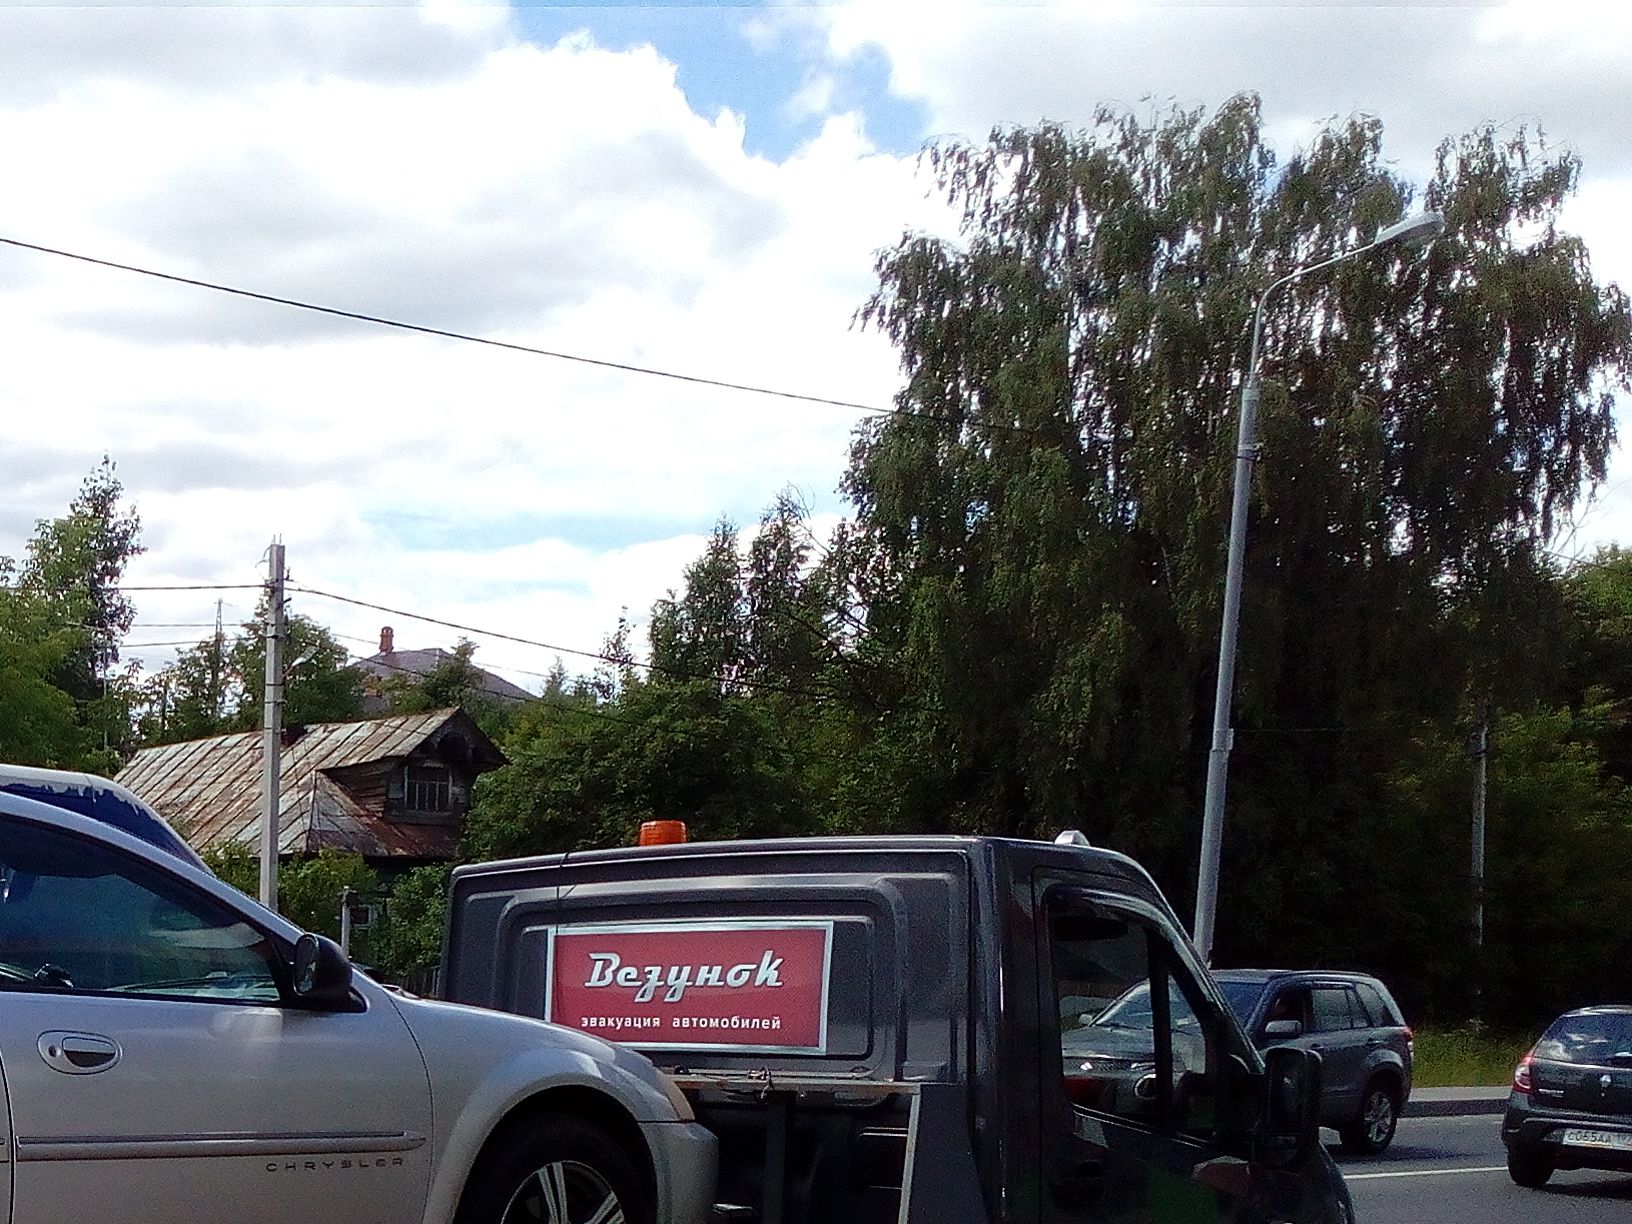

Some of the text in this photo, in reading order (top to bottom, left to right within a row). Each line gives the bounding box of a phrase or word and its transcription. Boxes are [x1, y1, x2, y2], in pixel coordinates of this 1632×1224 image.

[583, 949, 785, 1003] Везунок
[580, 1015, 782, 1030] эвакуация автомобилей
[265, 1157, 404, 1172] CHRYSLER
